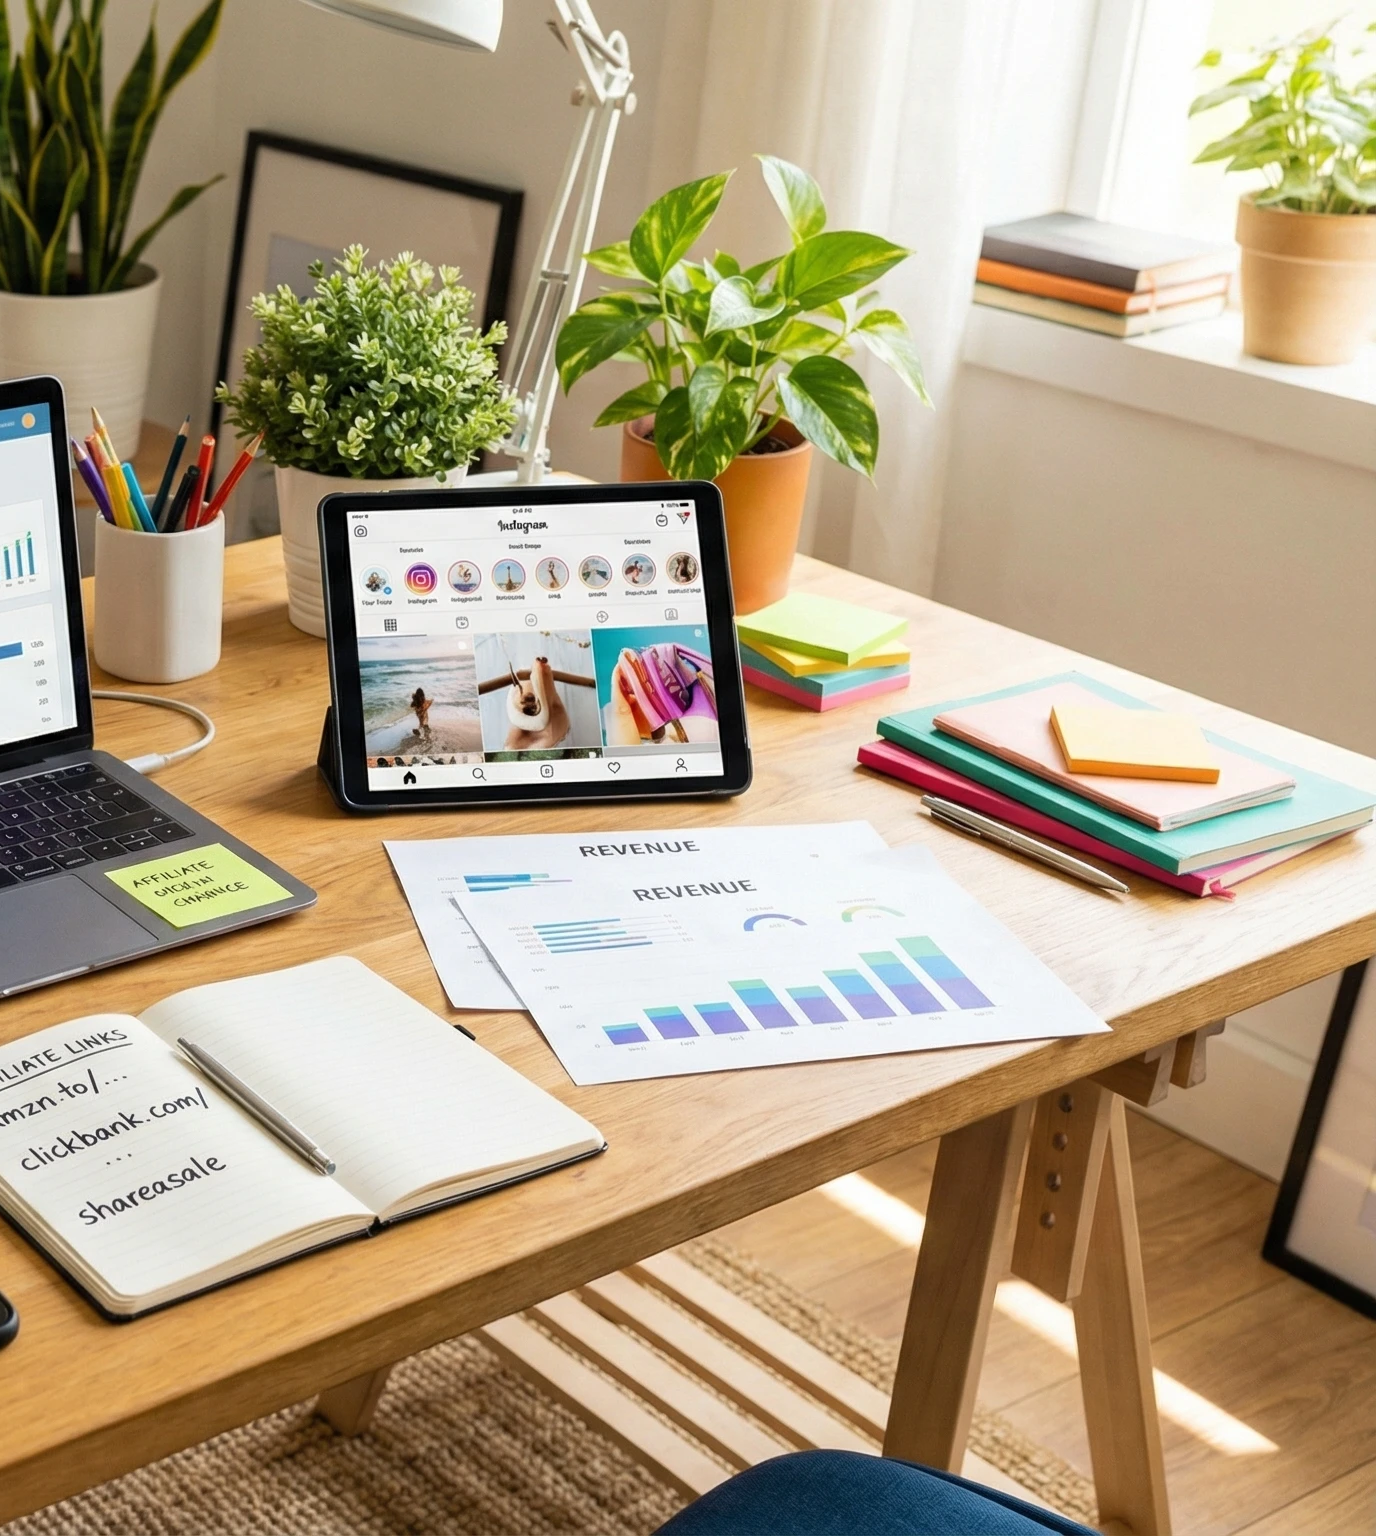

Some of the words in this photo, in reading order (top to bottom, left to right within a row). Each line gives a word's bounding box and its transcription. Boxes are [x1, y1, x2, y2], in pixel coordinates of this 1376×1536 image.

[579, 840, 701, 857] REVENUE
[132, 860, 215, 889] AFFILIATE
[632, 879, 757, 902] REVENUE
[64, 1029, 128, 1055] LINKS
[20, 1086, 210, 1172] clickbank.com/
[78, 1154, 227, 1226] shareasale
